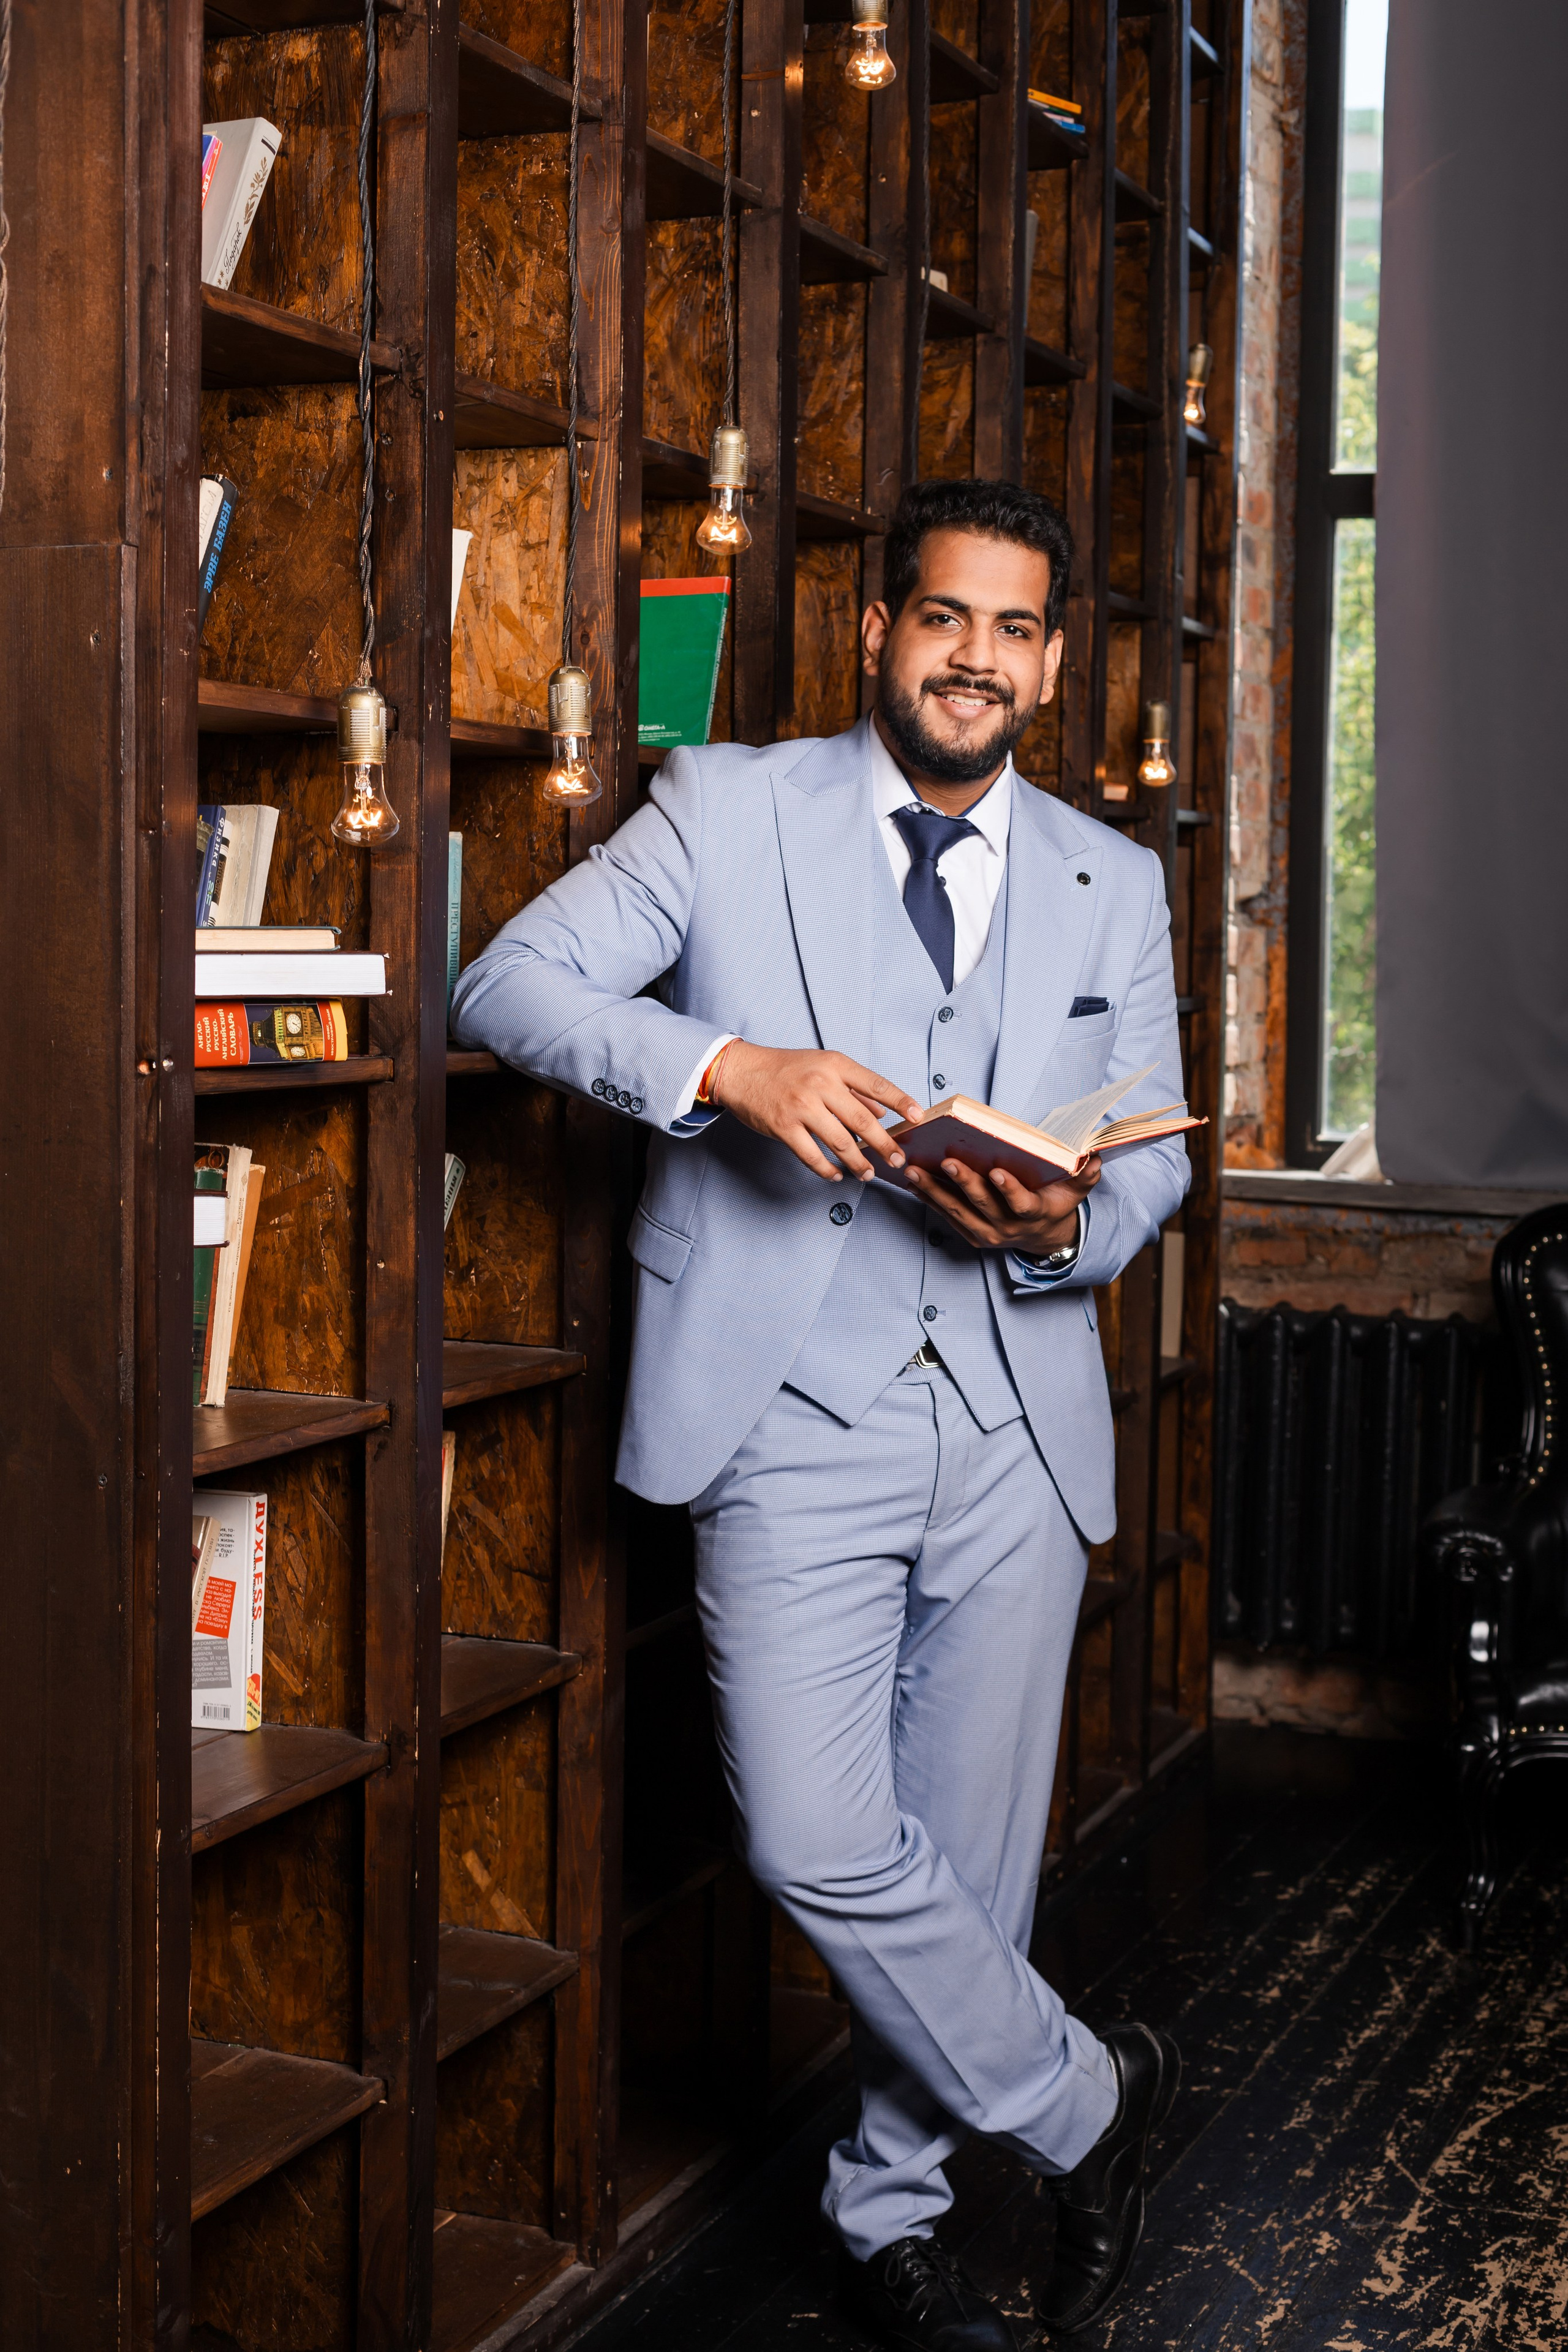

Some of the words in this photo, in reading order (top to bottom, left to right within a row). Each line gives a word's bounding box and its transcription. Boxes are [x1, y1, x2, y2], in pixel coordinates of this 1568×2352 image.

[203, 183, 209, 192] ДО
[223, 222, 242, 274] Подарок
[204, 552, 219, 593] ЭРВЕ
[213, 500, 232, 552] БАЗЕН
[212, 817, 225, 867] Физика
[206, 894, 212, 907] 11
[208, 880, 214, 892] 10
[203, 1017, 211, 1052] РУССКИЙ
[217, 1009, 227, 1060] АНГЛИЙСКИЙ
[227, 1011, 236, 1055] СЛОВАРЬ
[197, 1567, 206, 1597] РУССКОЙ
[205, 1538, 214, 1565] ПОЭЗИИ
[254, 1501, 265, 1620] ДУХLESS
